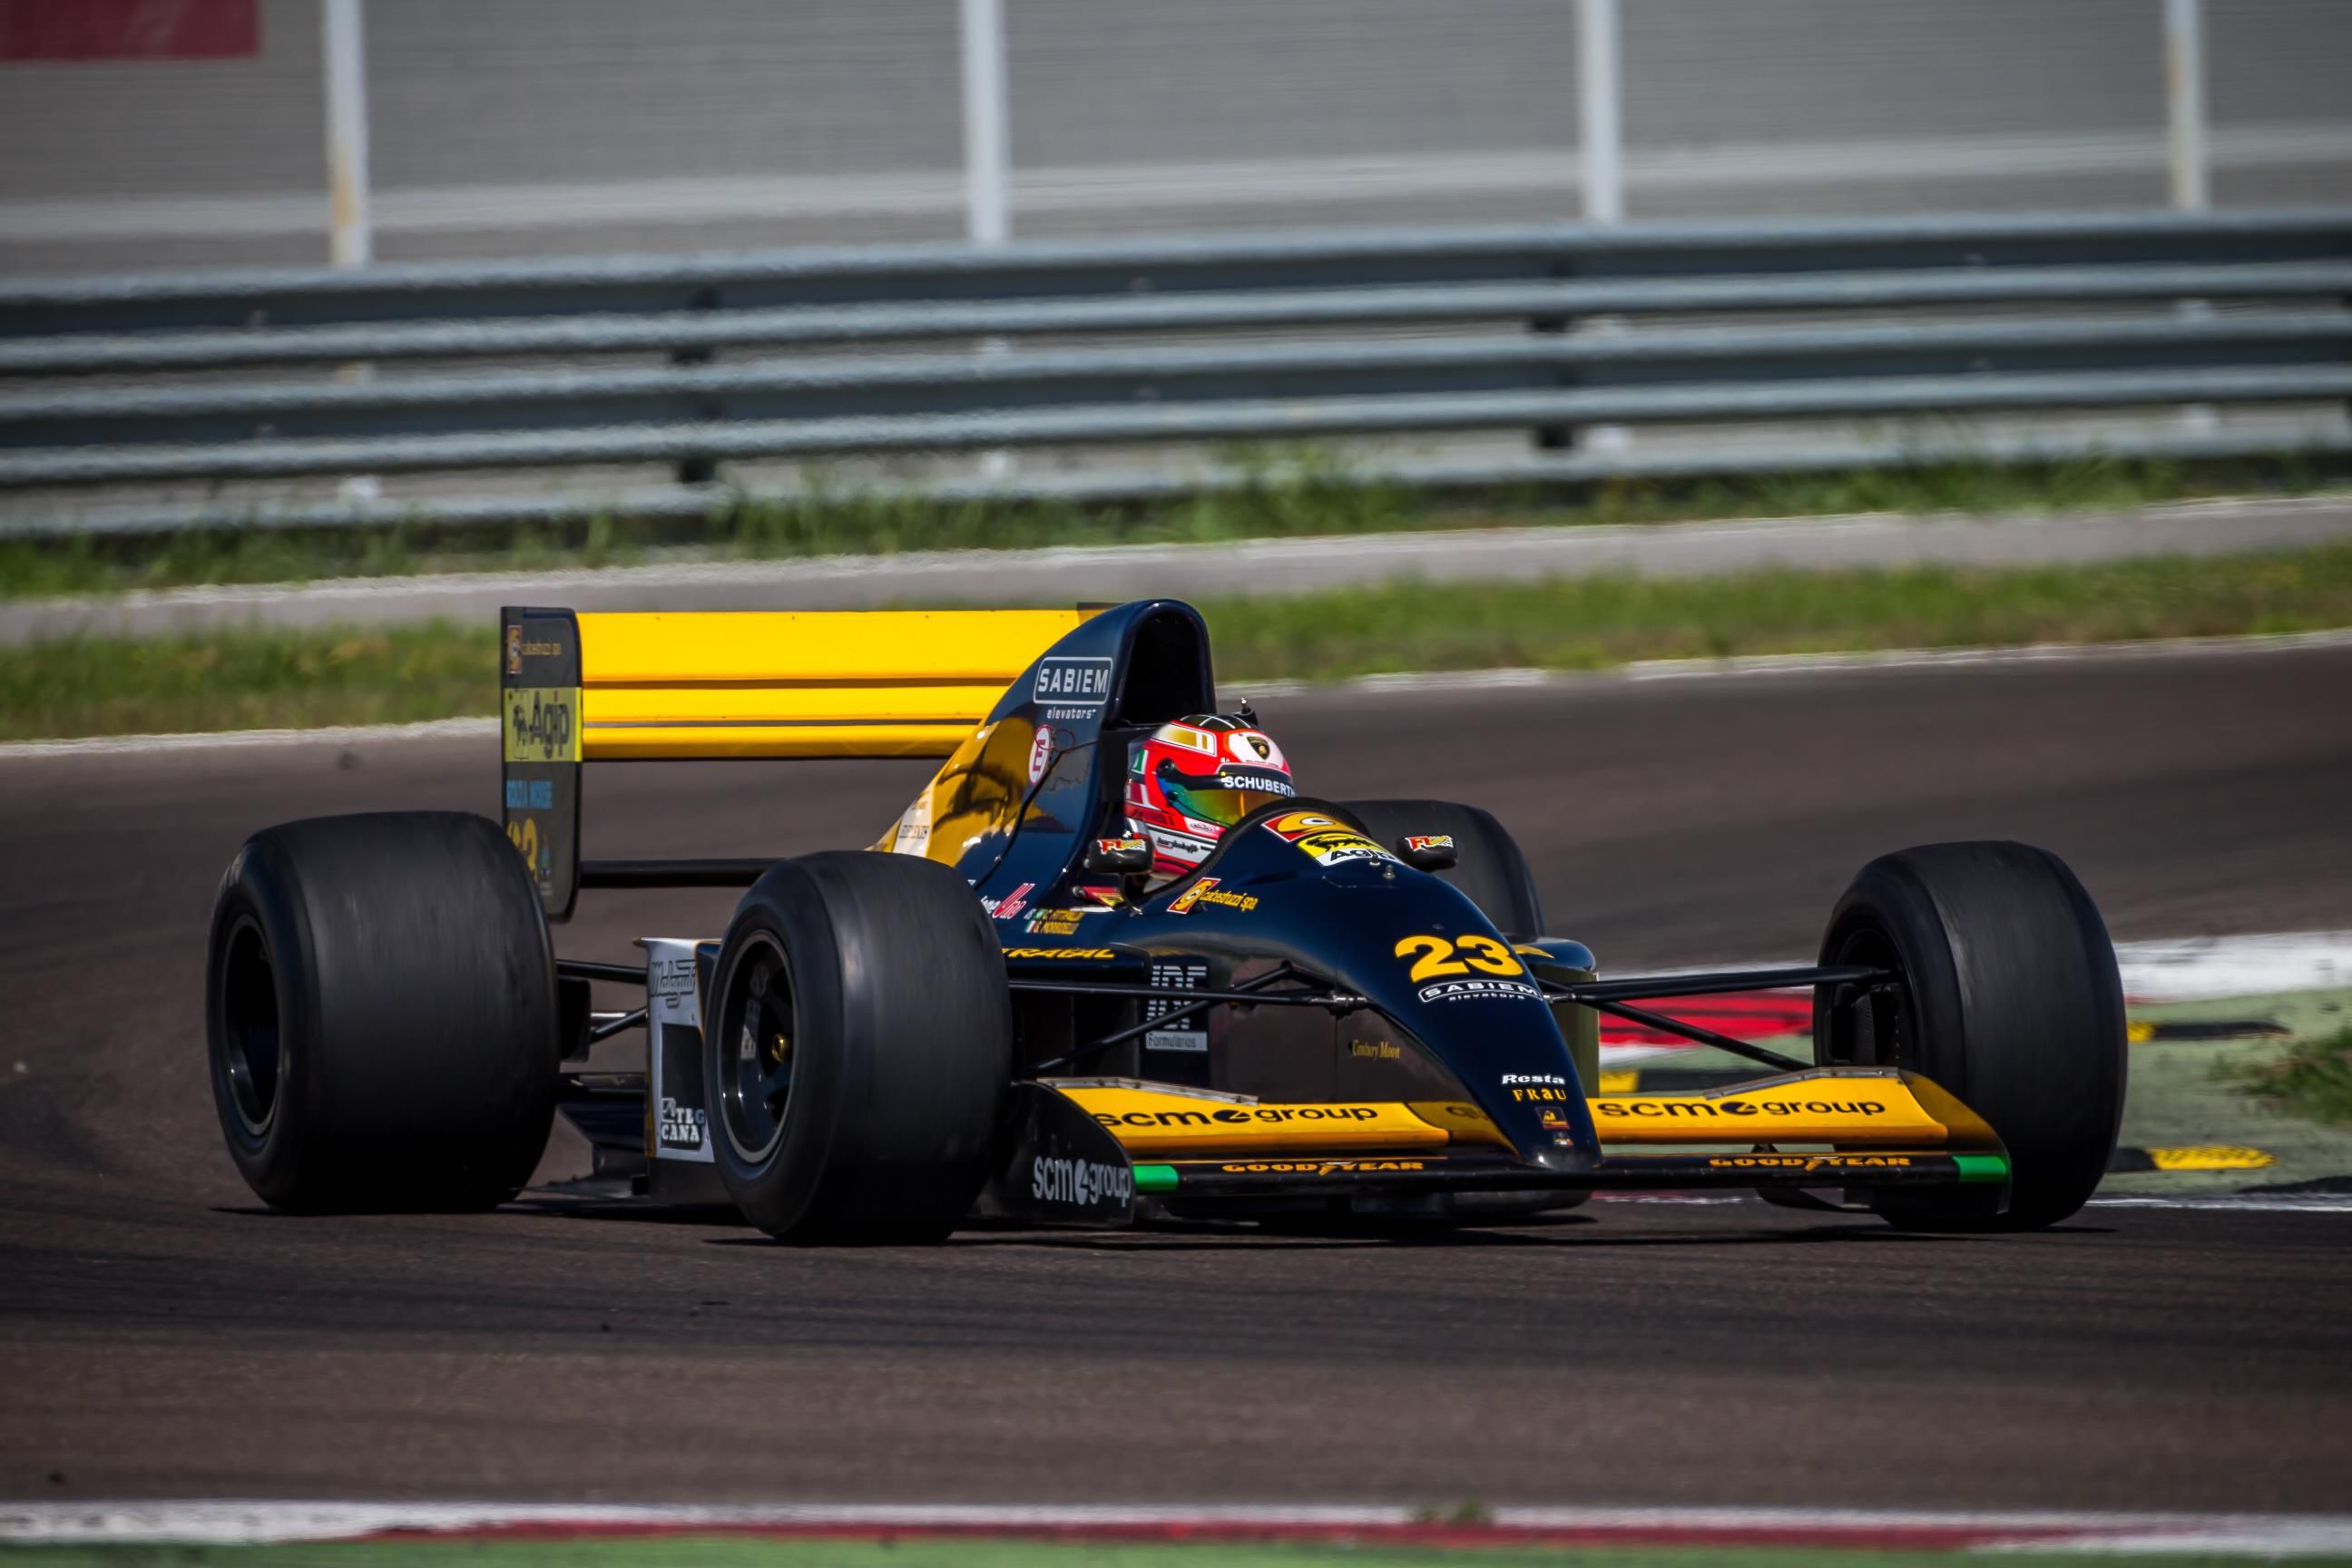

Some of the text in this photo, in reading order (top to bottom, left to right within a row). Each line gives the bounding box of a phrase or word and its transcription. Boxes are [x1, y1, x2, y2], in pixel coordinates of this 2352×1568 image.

[1038, 669, 1109, 693] SABIEM
[1046, 706, 1093, 720] elevators
[529, 691, 569, 760] Agip
[1395, 935, 1524, 983] 23
[1426, 982, 1538, 998] SABIEM
[1448, 992, 1525, 1002] elevators
[1502, 1073, 1565, 1085] Resta
[1091, 1107, 1379, 1127] scm group
[1597, 1099, 1886, 1117] scm group
[1032, 1155, 1132, 1208] scm group
